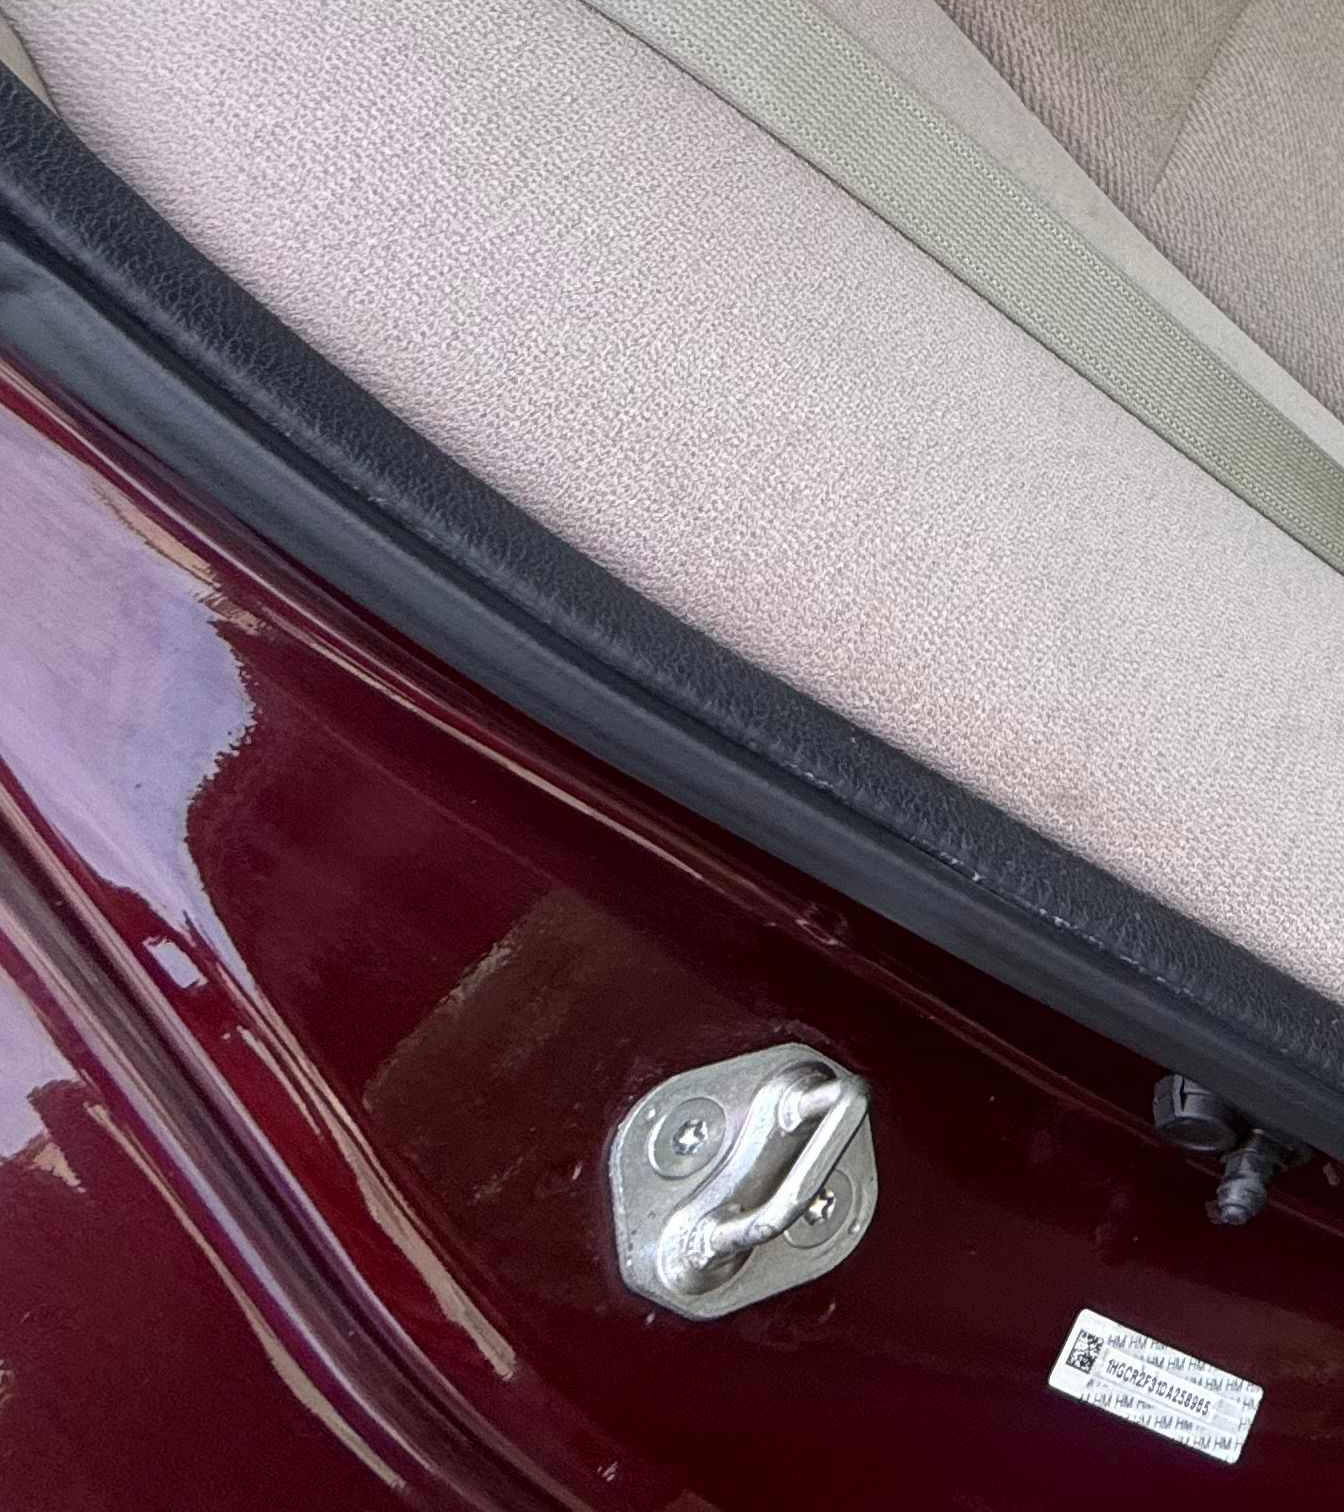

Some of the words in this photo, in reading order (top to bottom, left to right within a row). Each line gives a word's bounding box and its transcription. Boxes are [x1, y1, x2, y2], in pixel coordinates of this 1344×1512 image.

[1107, 1334, 1128, 1349] HM
[1167, 1357, 1186, 1371] HM
[1114, 1393, 1135, 1409] HM
[1153, 1415, 1174, 1429] HM
[1213, 1436, 1233, 1450] HM
